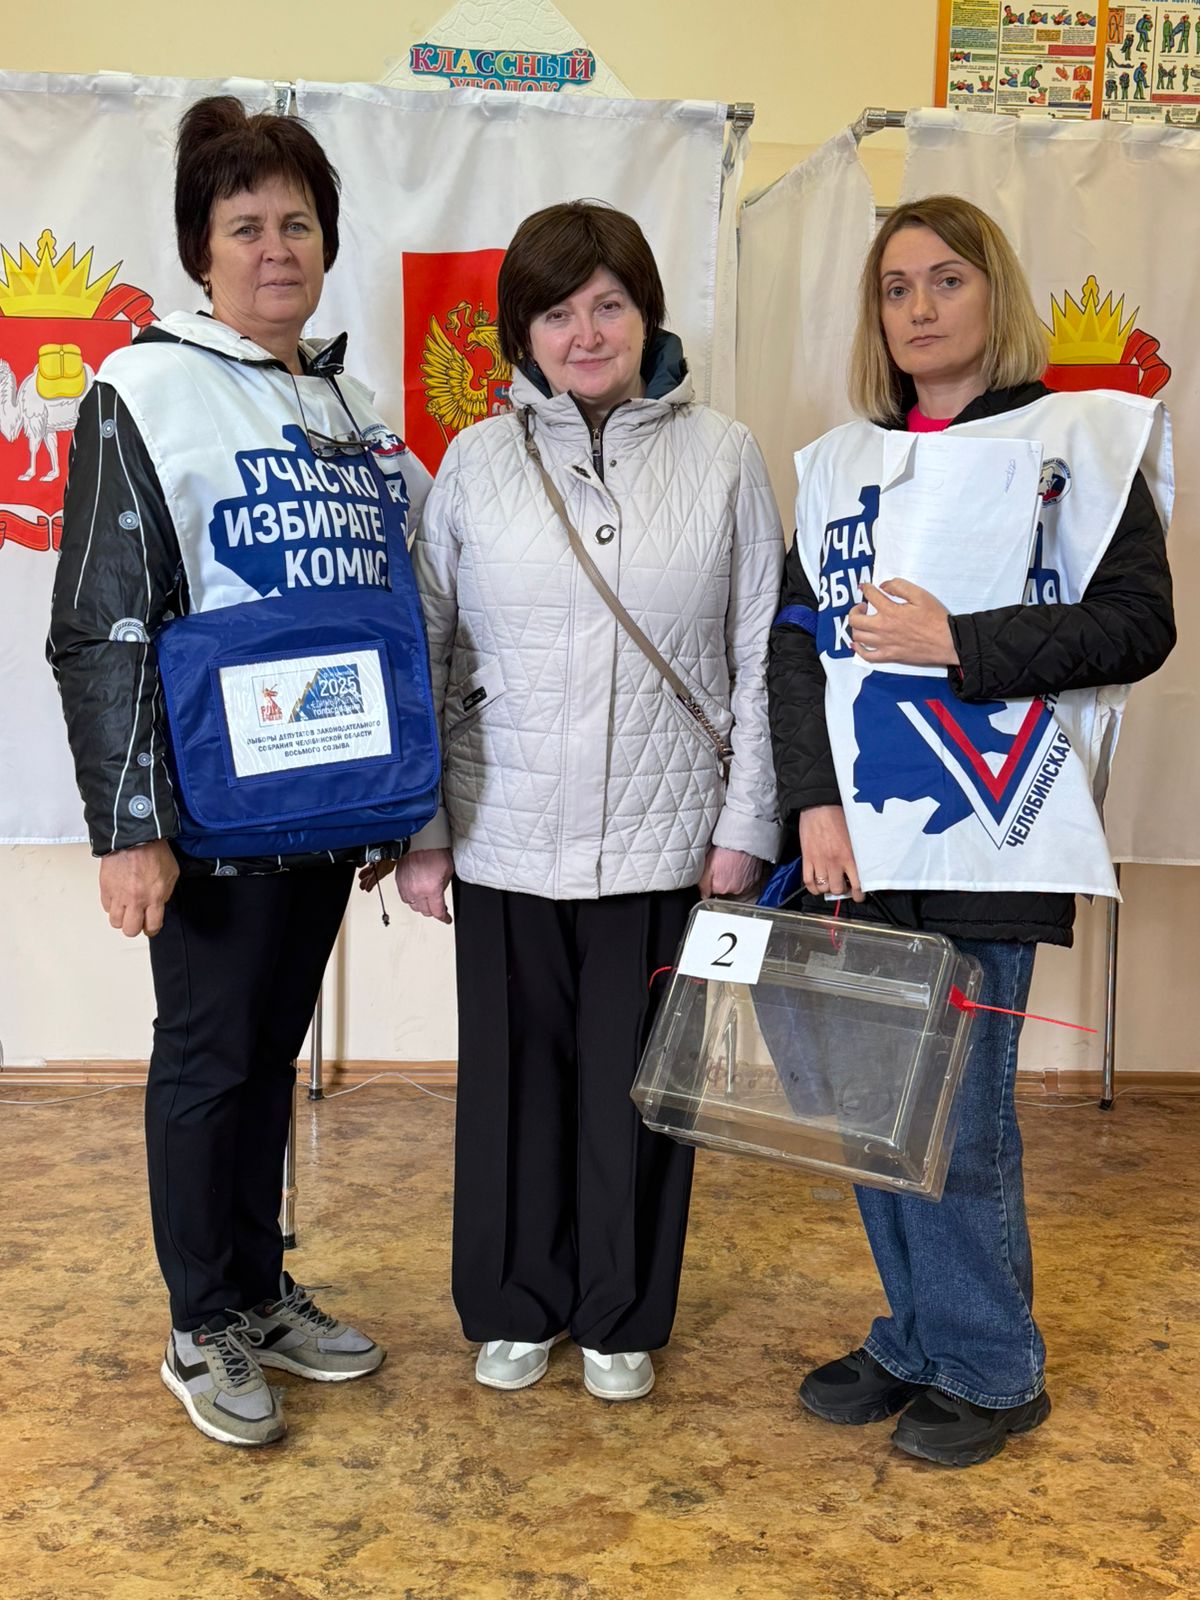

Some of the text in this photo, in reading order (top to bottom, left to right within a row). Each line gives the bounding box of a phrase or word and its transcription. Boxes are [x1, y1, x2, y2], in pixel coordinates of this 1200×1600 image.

[411, 47, 593, 81] КЛАССНЫЙ
[223, 501, 386, 547] ИЗБИРАТЕ
[285, 548, 388, 588] КОМИС
[320, 676, 357, 697] 2025
[258, 742, 293, 752] СОБРАНИЯ
[279, 729, 315, 741] ДЕПУТАТОВ
[317, 719, 381, 735] ЗАКОНОДАТЕЛЬНОГО
[284, 742, 350, 757] ВОСЬМОГО СОЗЫВА
[1005, 732, 1072, 847] ЧЕЛЯБИНСКАЯ
[710, 932, 738, 968] 2
